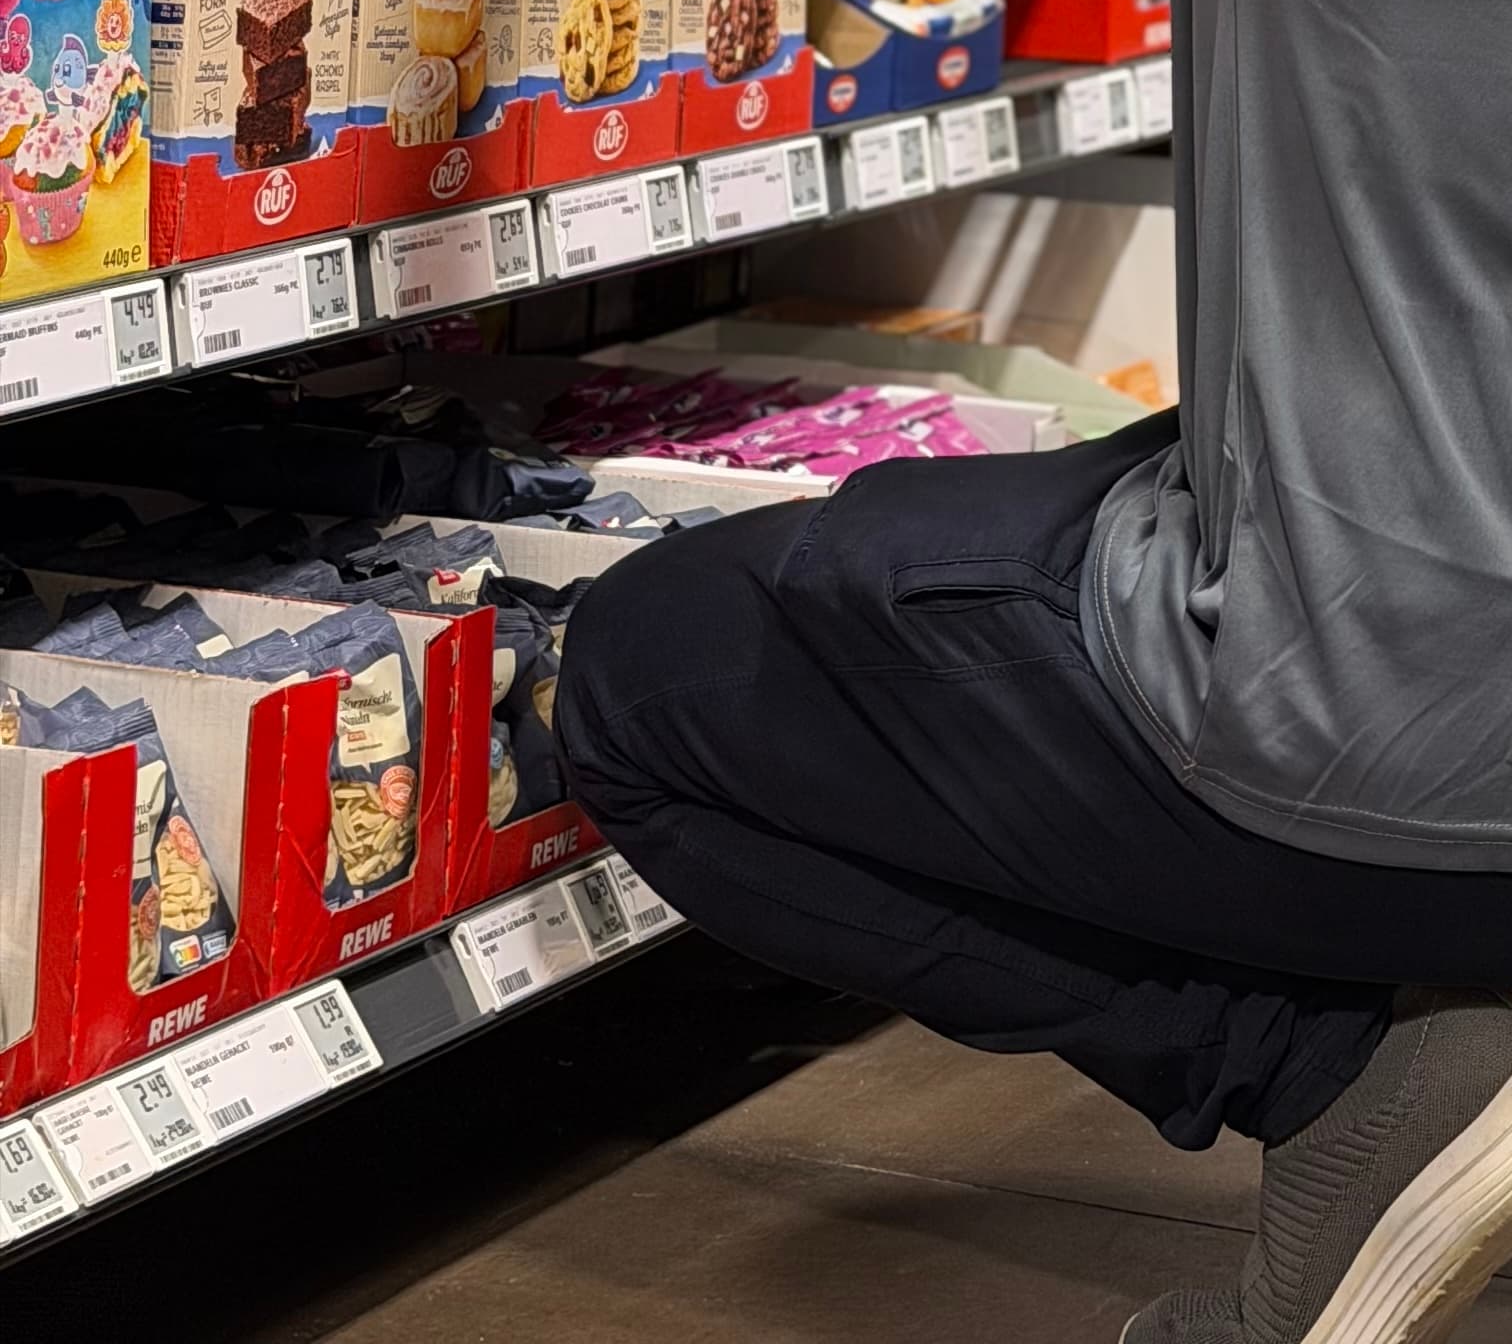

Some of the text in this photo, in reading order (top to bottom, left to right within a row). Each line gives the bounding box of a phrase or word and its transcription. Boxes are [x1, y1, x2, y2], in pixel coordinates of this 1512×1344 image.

[314, 63, 345, 78] SCHOKO
[741, 95, 764, 120] RUF
[598, 125, 624, 151] RUF
[435, 161, 467, 189] RUF
[259, 184, 292, 216] RUF
[501, 214, 525, 244] 2.69
[103, 249, 131, 269] 440g
[317, 252, 344, 286] 2.79
[123, 295, 155, 328] 4.49
[530, 824, 580, 869] REWE
[338, 912, 395, 961] REWE
[147, 993, 209, 1048] REWE
[313, 997, 344, 1030] 1.99
[132, 1073, 173, 1113] 2.49
